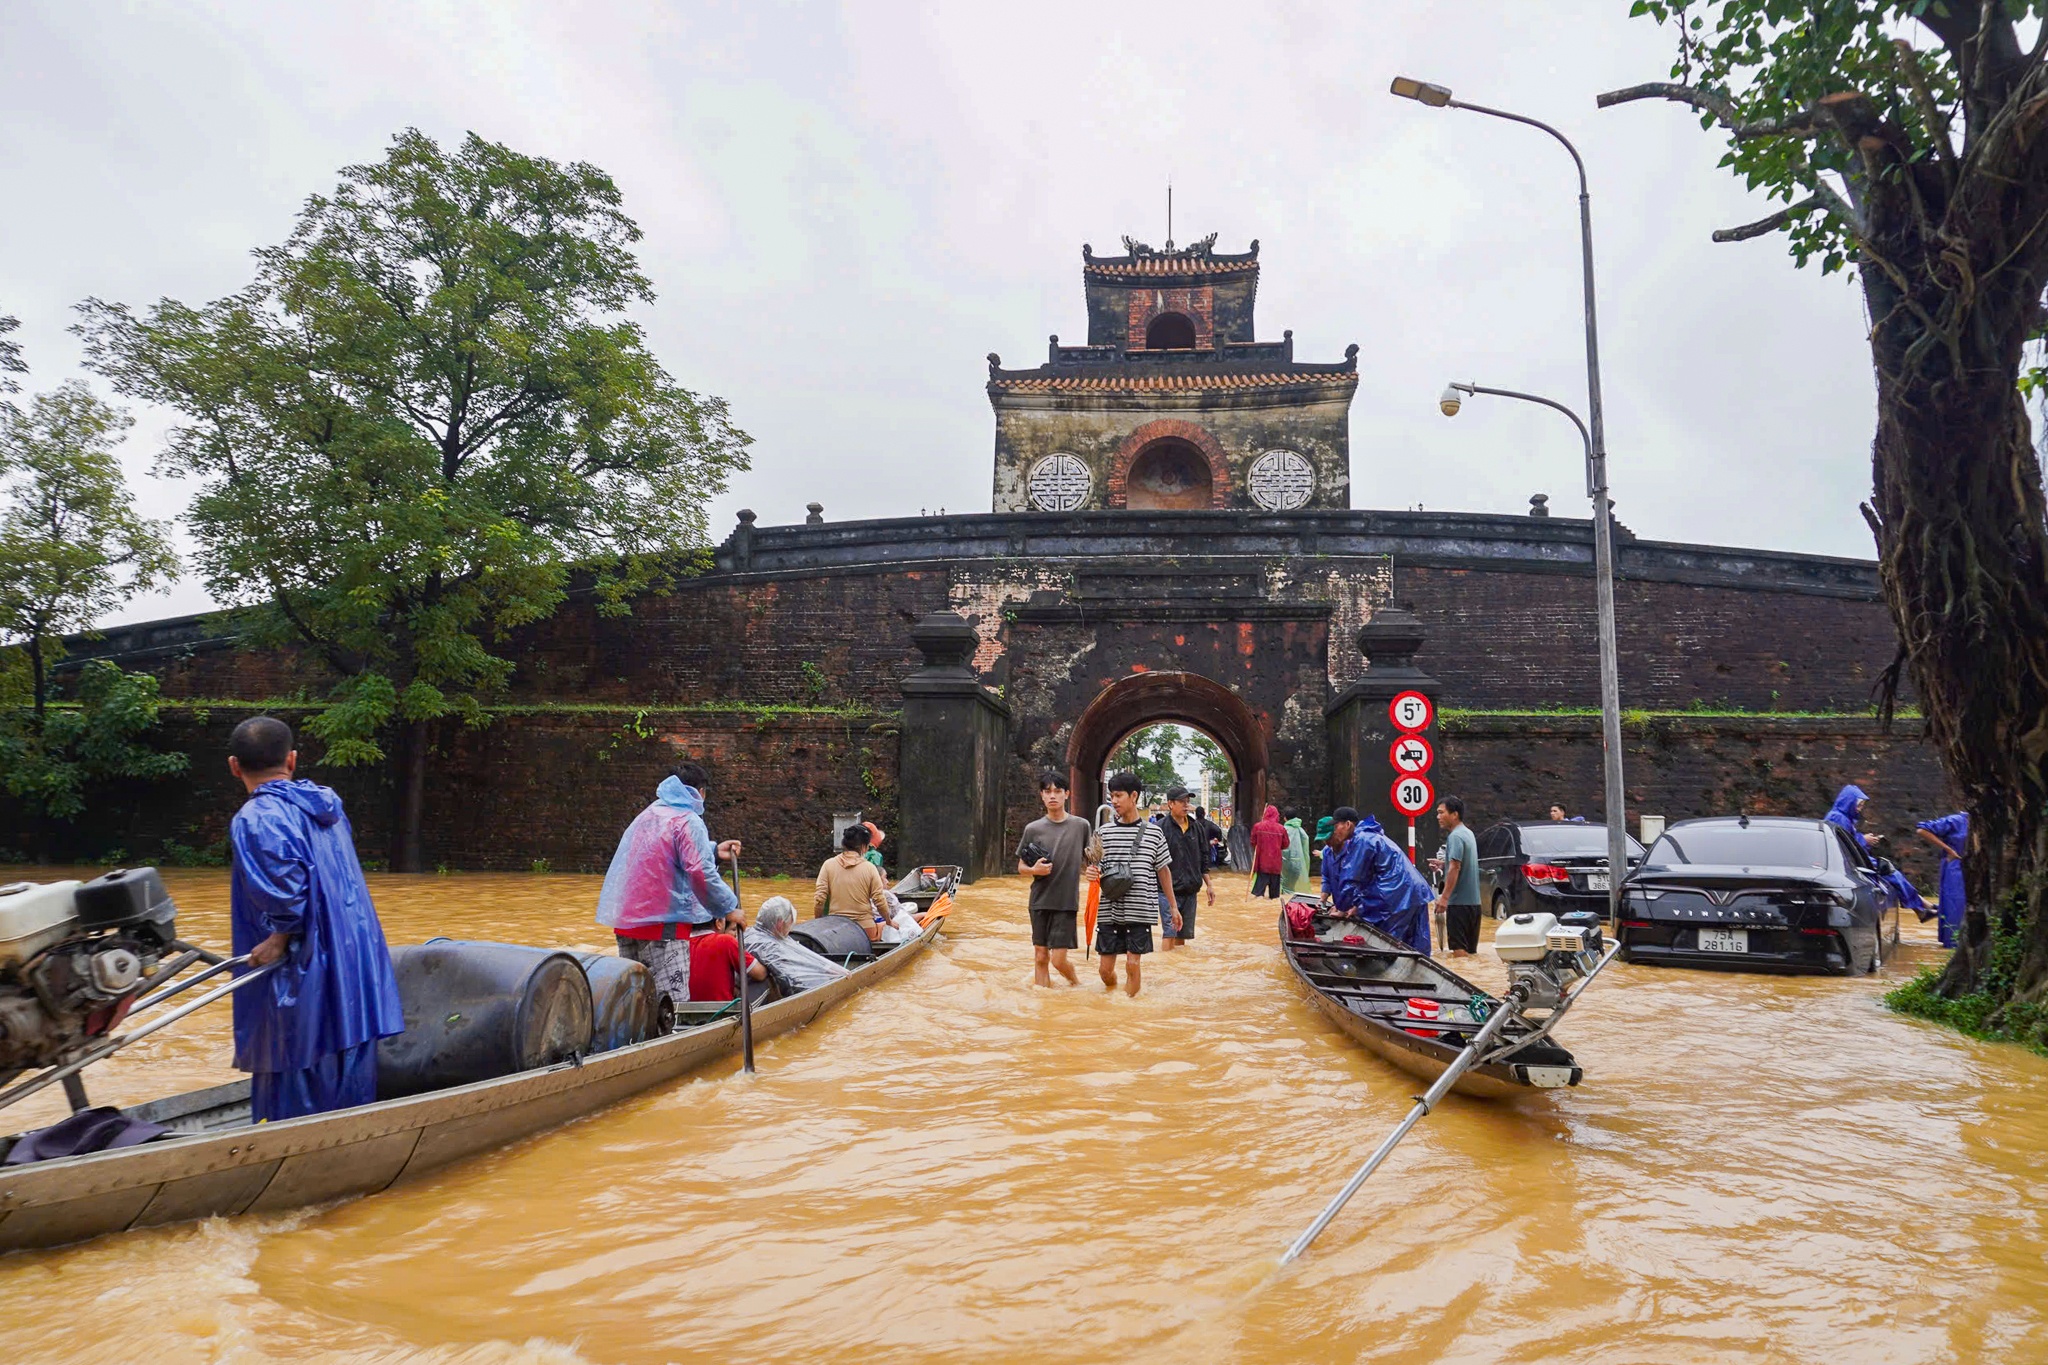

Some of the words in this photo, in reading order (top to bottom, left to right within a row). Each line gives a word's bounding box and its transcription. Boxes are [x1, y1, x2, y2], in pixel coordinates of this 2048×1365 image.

[1404, 703, 1422, 721] 5T
[1403, 786, 1422, 804] 30
[1672, 909, 1773, 919] VINFAST
[1713, 930, 1734, 941] 75A
[1704, 940, 1743, 952] 281.16
